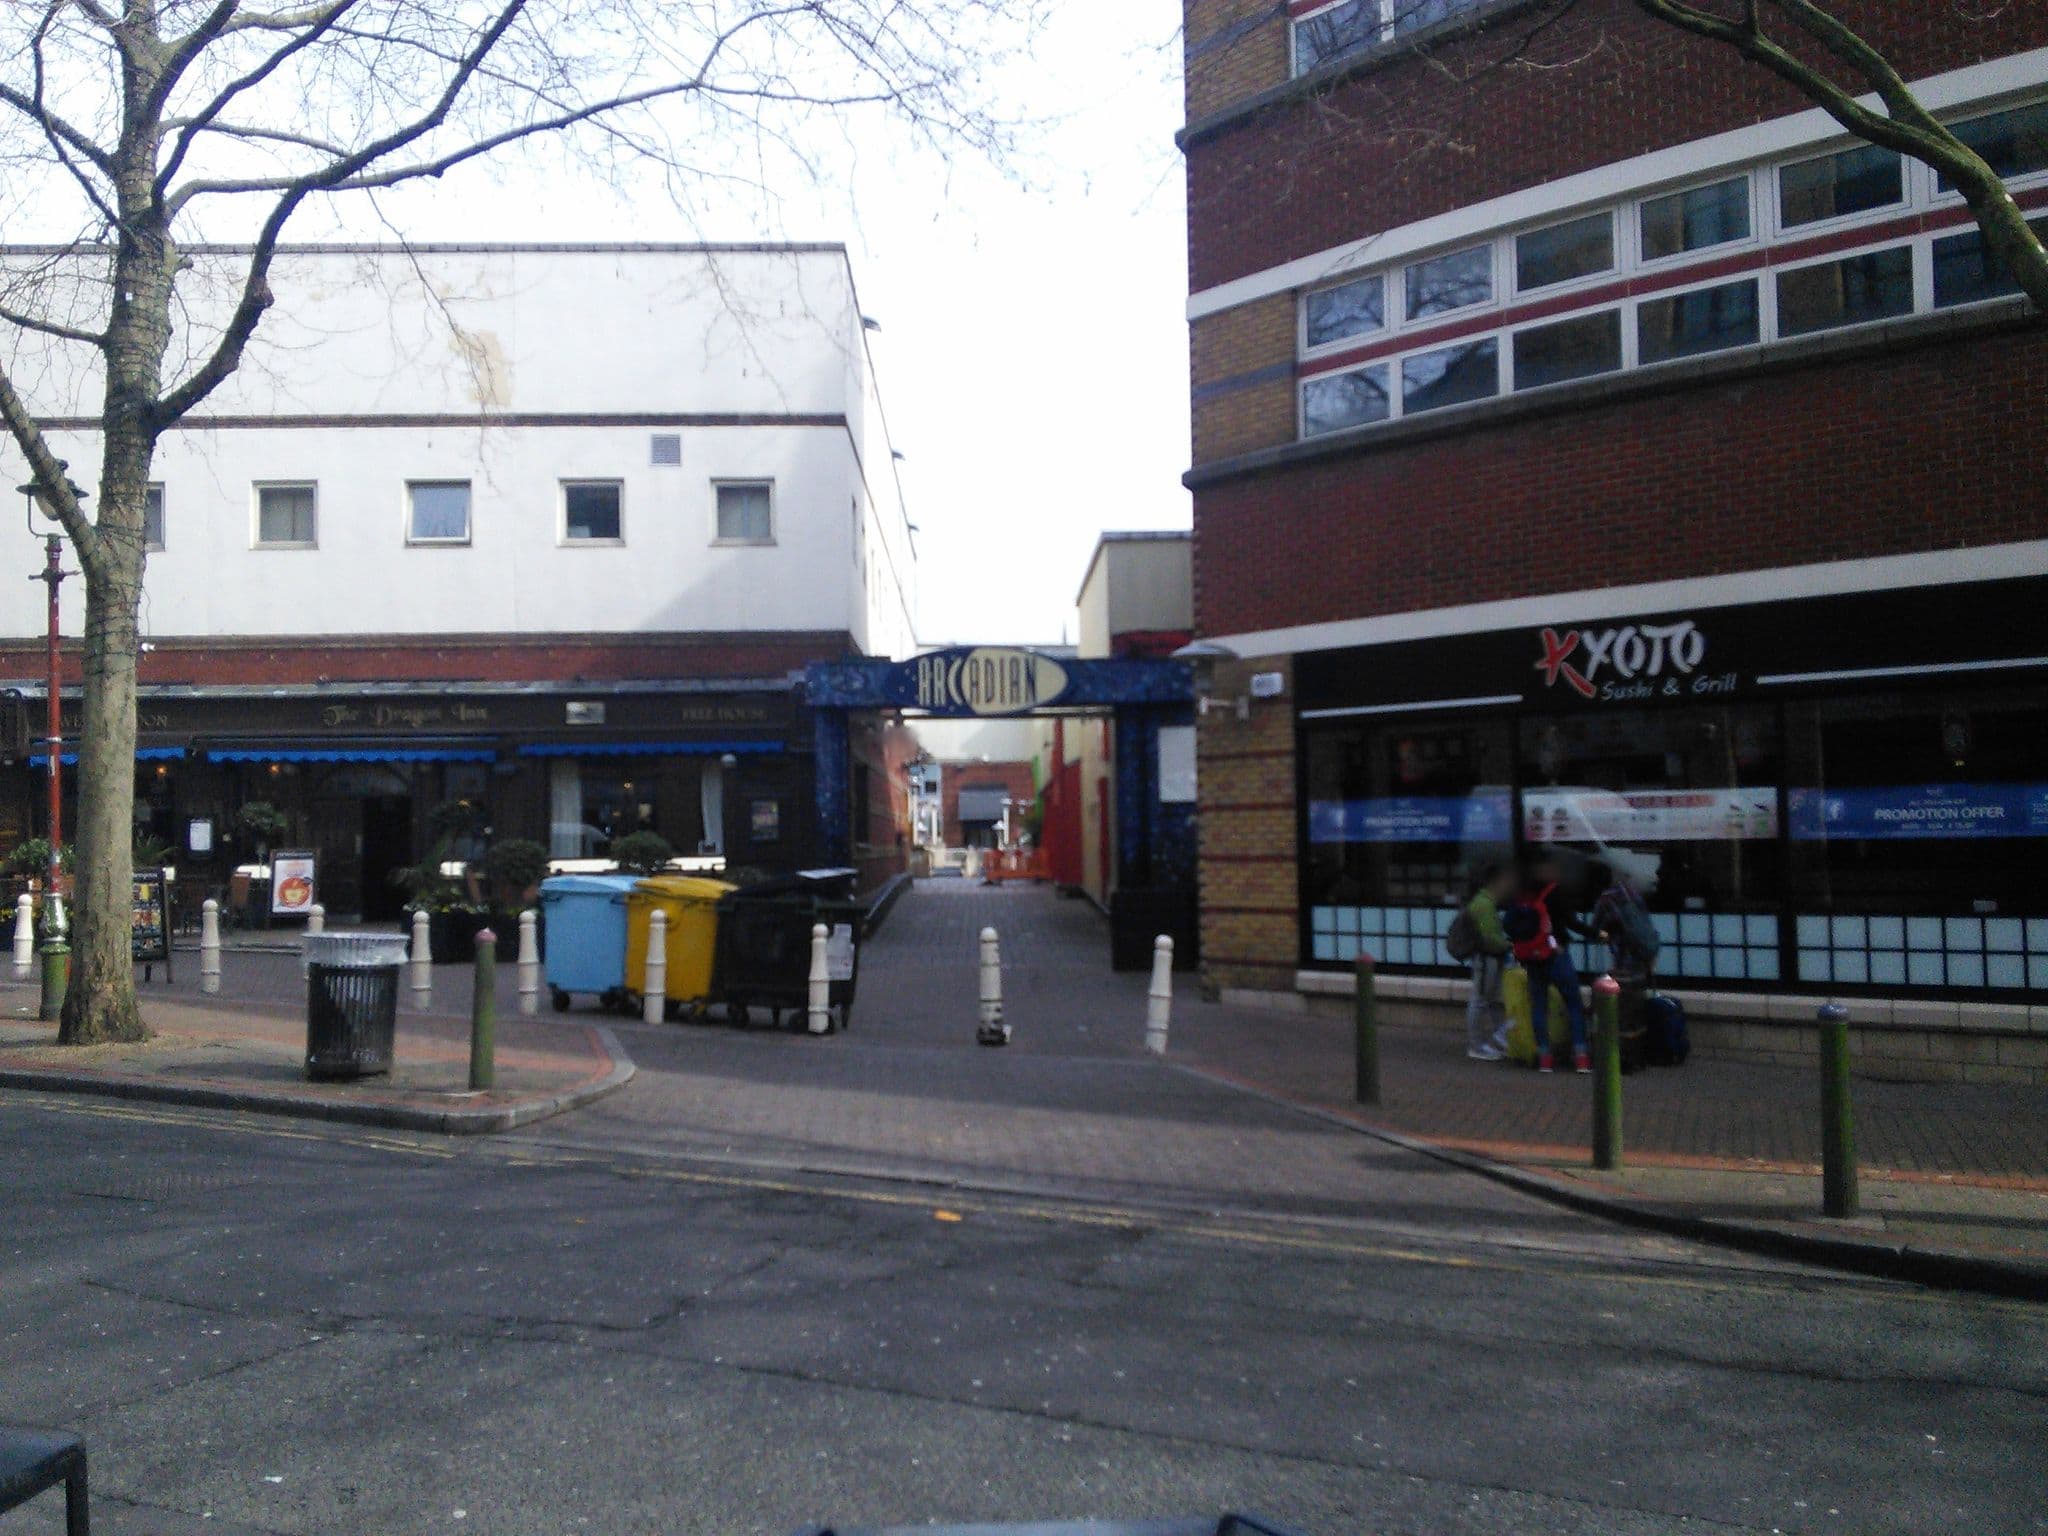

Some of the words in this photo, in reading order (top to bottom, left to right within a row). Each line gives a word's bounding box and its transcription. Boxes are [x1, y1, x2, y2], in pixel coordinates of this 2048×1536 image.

[1535, 620, 1705, 699] KYOTO
[918, 656, 1037, 706] ARCADIAN
[1600, 680, 1654, 701] Sushi
[1663, 677, 1680, 696] &
[1692, 672, 1738, 695] Grill
[1874, 807, 1959, 821] PROMOTION
[1960, 806, 2006, 819] OFFER
